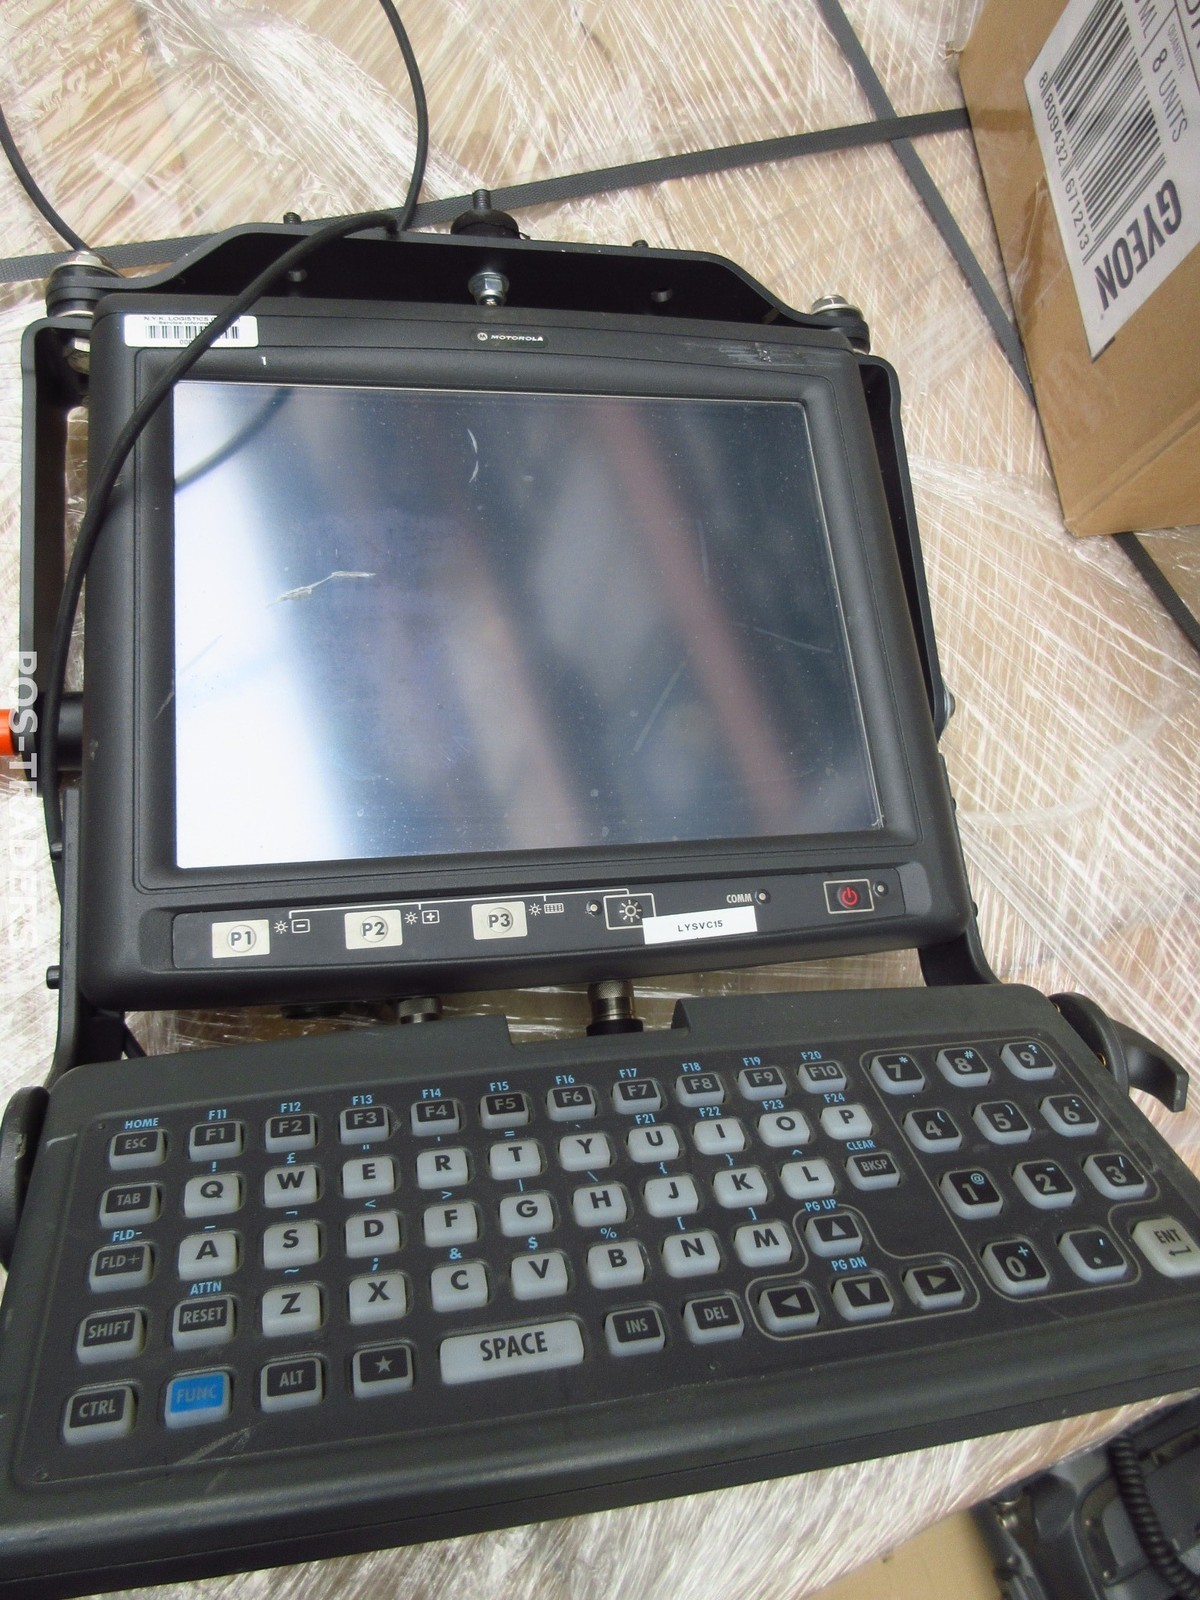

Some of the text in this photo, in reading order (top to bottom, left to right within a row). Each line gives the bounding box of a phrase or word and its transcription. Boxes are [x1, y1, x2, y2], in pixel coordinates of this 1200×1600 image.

[1152, 48, 1188, 142] 8 UNITS
[1064, 177, 1090, 251] 671213
[1094, 179, 1183, 312] GYEON
[726, 893, 752, 904] COMM
[488, 912, 511, 928] P3
[677, 920, 724, 932] LYSVC15
[362, 922, 385, 936] P2
[230, 930, 252, 946] P1
[742, 1056, 761, 1067] F19
[801, 1050, 822, 1061] F20
[1019, 1052, 1036, 1066] 9
[682, 1062, 701, 1072] F18
[808, 1065, 838, 1079] F10
[887, 1064, 902, 1079] 7
[954, 1057, 972, 1072] 8
[555, 1074, 576, 1085] F16
[619, 1068, 638, 1079] F17
[752, 1071, 774, 1084] F9
[489, 1080, 510, 1092] F15
[626, 1083, 648, 1096] F7
[690, 1077, 713, 1091] F8
[352, 1094, 373, 1106] F13
[422, 1088, 442, 1100] F14
[561, 1090, 584, 1104] F6
[824, 1092, 846, 1104] F24
[281, 1102, 301, 1114] F12
[424, 1104, 448, 1118] F4
[494, 1096, 517, 1111] F5
[762, 1100, 784, 1111] F23
[208, 1109, 227, 1120] F11
[353, 1110, 378, 1125] F3
[634, 1113, 656, 1126] F21
[699, 1106, 722, 1118] F22
[838, 1109, 855, 1125] P
[1063, 1107, 1080, 1122] 6
[124, 1117, 159, 1130] HOME
[278, 1119, 302, 1134] F2
[776, 1116, 796, 1132] O
[925, 1120, 942, 1137] 4
[993, 1114, 1012, 1130] 5
[205, 1127, 226, 1142] F1
[645, 1131, 664, 1147] U
[716, 1124, 726, 1139] I
[124, 1137, 148, 1150] ESC
[576, 1138, 592, 1154] Y
[846, 1140, 876, 1151] CLEAR
[286, 1152, 296, 1164] £
[508, 1146, 522, 1162] T
[212, 1161, 217, 1172] !
[362, 1162, 376, 1180] E
[434, 1154, 452, 1172] R
[860, 1158, 888, 1172] BKSP
[276, 1170, 305, 1190] W
[730, 1172, 754, 1191] K
[802, 1166, 820, 1182] L
[970, 1174, 985, 1185] @
[1106, 1166, 1126, 1184] 3
[200, 1180, 224, 1199] Q
[668, 1182, 680, 1200] J
[1036, 1174, 1057, 1192] 2
[116, 1192, 142, 1206] TAB
[590, 1190, 612, 1209] H
[962, 1183, 978, 1201] 1
[516, 1200, 538, 1218] G
[805, 1198, 838, 1212] PG UP
[444, 1208, 458, 1228] F
[112, 1230, 143, 1243] FLD-
[363, 1220, 384, 1238] D
[600, 1226, 618, 1240] %
[1152, 1228, 1182, 1245] ENT
[282, 1228, 300, 1248] S
[528, 1236, 539, 1250] $
[752, 1228, 780, 1248] M
[195, 1240, 220, 1260] A
[449, 1248, 462, 1260] &
[680, 1238, 706, 1258] N
[100, 1253, 140, 1270] FLD+
[607, 1249, 628, 1268] B
[831, 1256, 868, 1272] PG DN
[528, 1258, 550, 1279] V
[1006, 1256, 1028, 1278] 0
[190, 1280, 222, 1296] ATTN
[450, 1270, 470, 1290] C
[368, 1280, 391, 1302] X
[280, 1292, 301, 1316] Z
[182, 1306, 224, 1326] RESET
[704, 1306, 728, 1322] DEL
[88, 1320, 131, 1340] SHIFT
[624, 1318, 649, 1336] INS
[480, 1330, 548, 1362] SPACE
[279, 1369, 304, 1388] ALT
[176, 1383, 218, 1404] FUNC
[78, 1398, 116, 1419] CTRL
